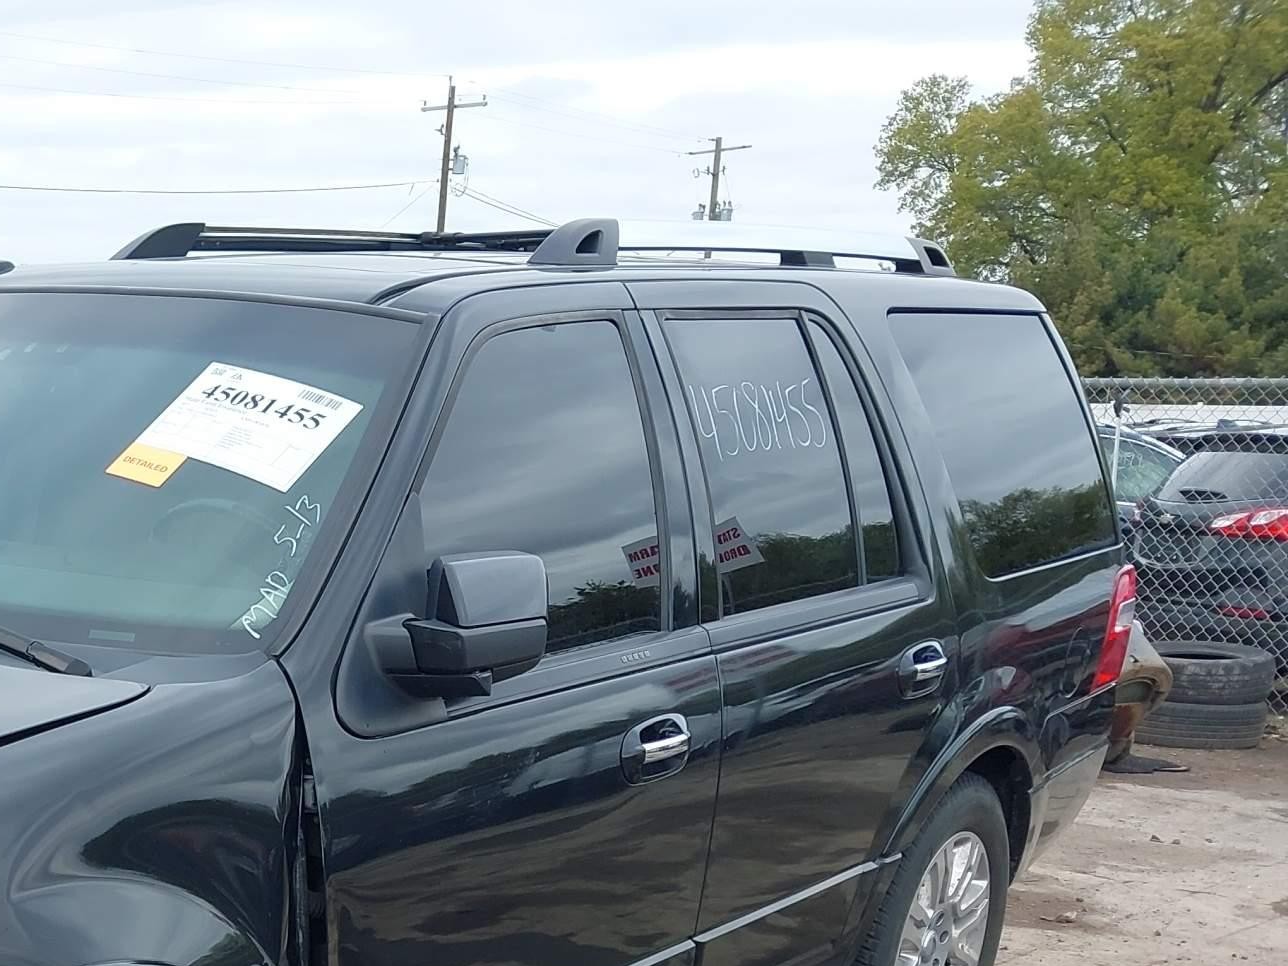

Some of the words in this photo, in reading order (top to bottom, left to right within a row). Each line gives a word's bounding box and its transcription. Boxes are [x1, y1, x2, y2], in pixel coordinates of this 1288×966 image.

[201, 384, 328, 431] 45081455
[688, 377, 826, 462] 45081455
[123, 455, 168, 474] DETAILED
[273, 495, 321, 557] 5-13
